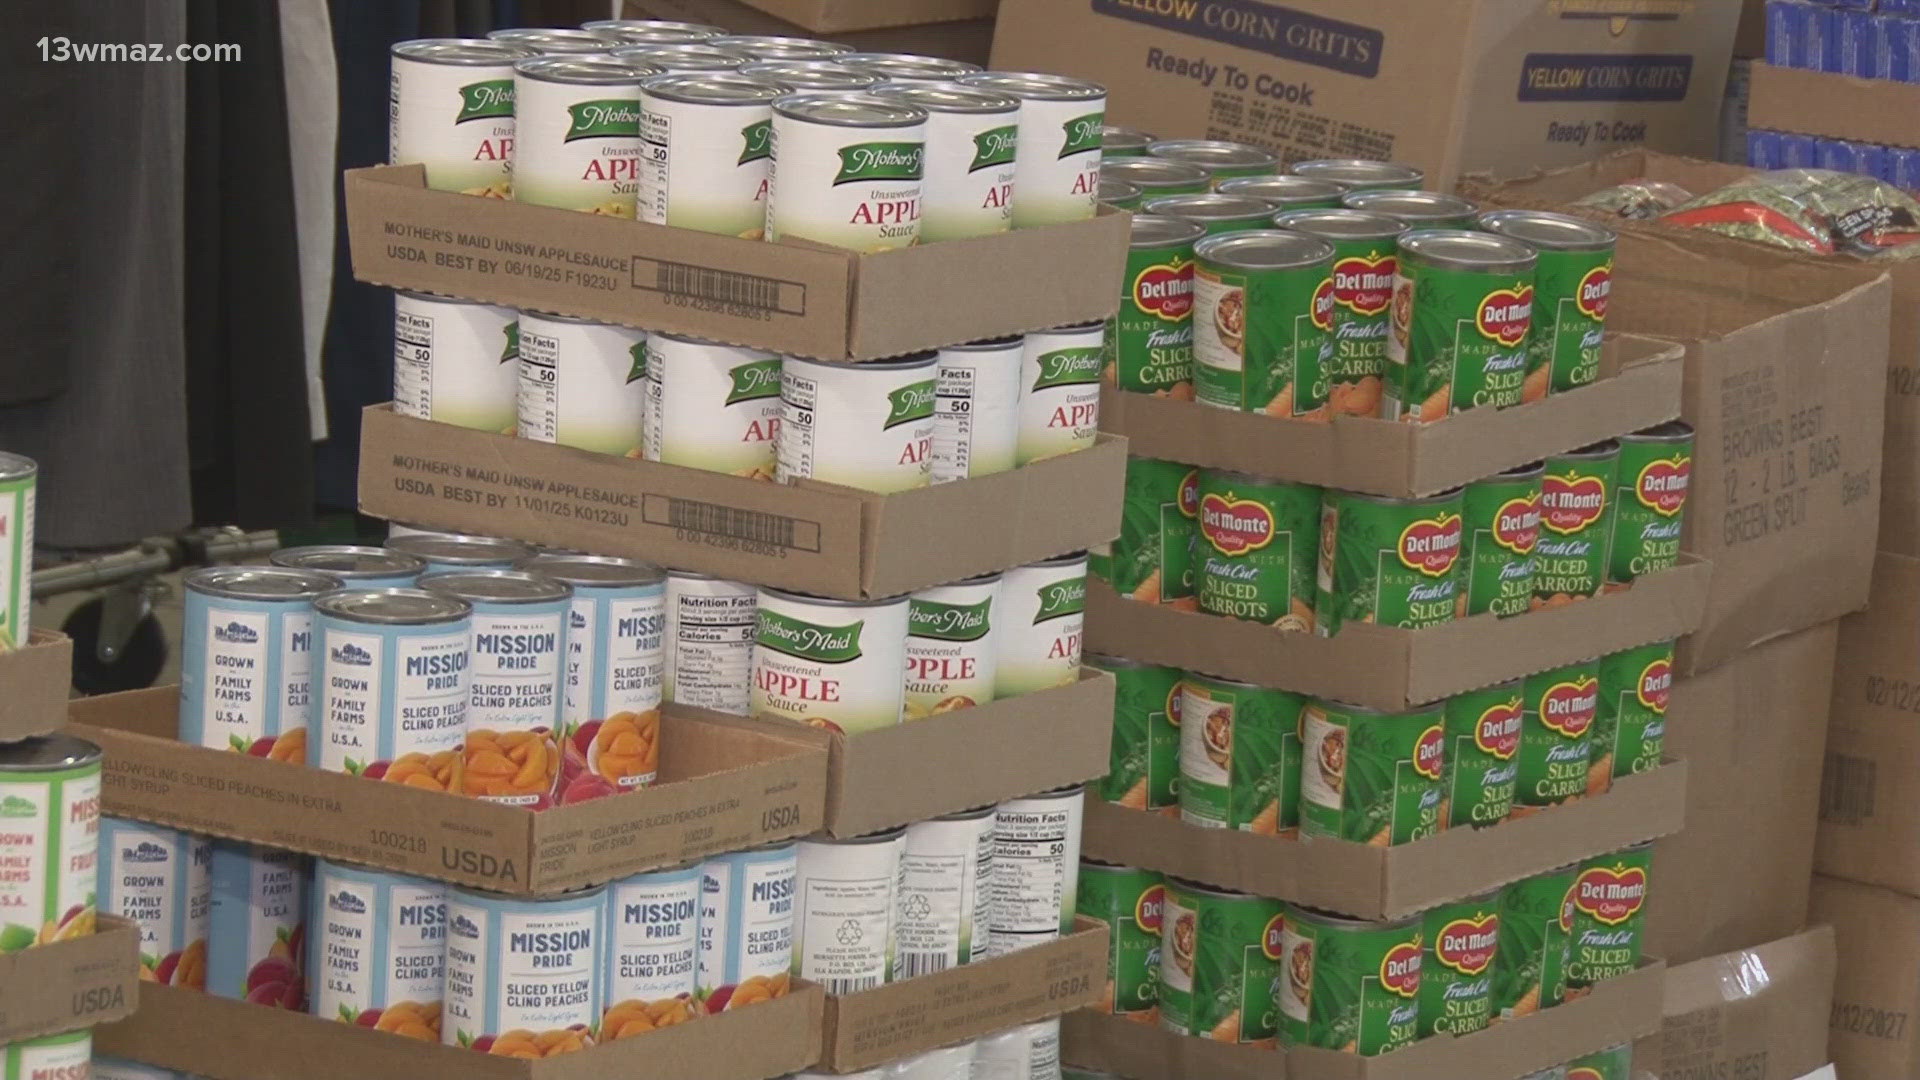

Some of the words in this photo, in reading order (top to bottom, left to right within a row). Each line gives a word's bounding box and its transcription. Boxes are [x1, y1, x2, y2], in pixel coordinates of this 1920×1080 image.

[1203, 3, 1280, 40] CORN
[1286, 23, 1372, 64] GRITS
[1146, 47, 1217, 87] Ready
[1223, 65, 1249, 91] To
[1255, 74, 1314, 107] Cook
[1527, 67, 1586, 88] YELLOW
[1587, 66, 1633, 88] CORN
[1636, 67, 1684, 88] GRITS
[1547, 121, 1590, 146] Ready
[1594, 122, 1608, 142] To
[1612, 121, 1648, 142] Cook
[653, 148, 667, 160] 50
[879, 225, 914, 238] Sauce
[384, 221, 453, 244] MOTHER'S
[457, 232, 491, 250] MAID
[496, 239, 536, 257] UNSW
[539, 245, 629, 273] APPLESAUCE
[387, 245, 427, 264] USDA
[436, 252, 473, 271] BEST
[478, 259, 498, 274] BY
[505, 259, 562, 283] 06/19/25
[566, 270, 617, 292] F1923U
[1335, 273, 1360, 288] Del
[1141, 281, 1168, 299] Del
[1485, 306, 1507, 322] Del
[1336, 321, 1371, 339] Fresh
[1146, 329, 1180, 348] Fresh
[414, 349, 430, 362] 50
[540, 370, 555, 382] 50
[940, 368, 972, 380] Facts
[651, 385, 662, 398] 50
[951, 401, 970, 412] 50
[798, 412, 812, 424] 50
[1790, 405, 1823, 443] BEST
[392, 454, 462, 478] MOTHER'S
[465, 466, 501, 484] MAID
[503, 472, 544, 490] UNSW
[547, 479, 639, 509] APPLESAUCE
[1644, 475, 1665, 491] Del
[395, 477, 436, 497] USDA
[443, 487, 483, 506] BEST
[487, 492, 506, 508] BY
[515, 495, 572, 517] 11/01/25
[575, 505, 629, 527] K0123U
[1559, 492, 1602, 508] Monte
[1203, 507, 1220, 525] Del
[1221, 512, 1268, 533] Monte
[1502, 515, 1521, 532] Del
[1215, 530, 1244, 546] Quality
[1407, 536, 1430, 553] Del
[1204, 558, 1230, 578] Fresh
[1534, 556, 1587, 575] SLICED
[1205, 575, 1257, 599] SLICED
[1406, 583, 1437, 602] Fresh
[681, 597, 728, 607] Nutrition
[1200, 591, 1268, 618] CARROTS
[1409, 600, 1454, 620] SLICED
[936, 609, 984, 633] Maid
[679, 630, 721, 641] Calories
[795, 628, 851, 651] Maid
[477, 633, 555, 655] MISSION
[636, 637, 661, 651] PRIDE
[215, 655, 254, 669] GROWN
[498, 656, 537, 669] PRIDE
[762, 657, 822, 677] Unsweetened
[614, 665, 645, 678] SLICED
[215, 676, 251, 689] FAMILY
[331, 677, 368, 692] GROWN
[427, 674, 458, 690] PRIDE
[472, 684, 512, 696] SLICED
[516, 683, 552, 696] YELLOW
[614, 678, 644, 691] CLING
[754, 667, 840, 702] APPLE
[215, 689, 251, 702] FARMS
[472, 696, 505, 708] CLING
[509, 695, 552, 708] PEACHES
[766, 693, 807, 714] Sauce
[331, 698, 366, 712] FAMILY
[403, 704, 439, 718] SLICED
[1548, 698, 1569, 715] Del
[215, 711, 248, 724] U.S.A.
[331, 711, 365, 725] FARMS
[402, 717, 434, 731] CLING
[1483, 721, 1502, 738] Del
[331, 734, 362, 747] U.S.A.
[131, 777, 170, 796] SYRUP
[144, 766, 178, 781] CLING
[182, 772, 225, 792] SLICED
[228, 779, 285, 802] PEACHES
[287, 792, 300, 804] IN
[302, 795, 342, 814] EXTRA
[645, 813, 673, 828] SLICED
[674, 806, 707, 824] PEACHES
[762, 804, 800, 832] USDA
[1042, 814, 1066, 823] Facts
[370, 829, 426, 854] 100218
[1050, 844, 1063, 854] 50
[440, 845, 518, 883] USDA
[124, 876, 164, 887] GROWN
[263, 872, 293, 885] FAMILY
[263, 884, 293, 897] FARMS
[1581, 882, 1605, 898] Del
[1607, 883, 1643, 899] Monte
[124, 896, 162, 907] FAMILY
[124, 909, 161, 919] FARMS
[625, 898, 695, 924] MISSION
[329, 923, 362, 939] GROWN
[646, 923, 682, 939] PRIDE
[748, 931, 778, 943] SLICED
[1578, 930, 1612, 946] Fresh
[511, 928, 591, 953] MISSION
[1444, 934, 1466, 951] Del
[328, 944, 359, 959] FAMILY
[620, 954, 660, 966] SLICED
[663, 949, 693, 963] YELLOW
[748, 944, 774, 955] CLING
[1580, 947, 1631, 964] SLICED
[328, 958, 359, 972] FARMS
[395, 956, 434, 968] SLICED
[532, 953, 573, 968] PRIDE
[1388, 960, 1406, 977] Del
[395, 968, 428, 980] CLING
[620, 966, 653, 978] CLING
[656, 961, 693, 976] PEACHES
[328, 979, 356, 994] U.S.A.
[507, 983, 548, 996] SLICED
[552, 979, 589, 994] YELLOW
[1049, 974, 1090, 1000] USDA
[73, 984, 124, 1016] USDA
[507, 995, 541, 1008] CLING
[545, 992, 588, 1007] PEACHES
